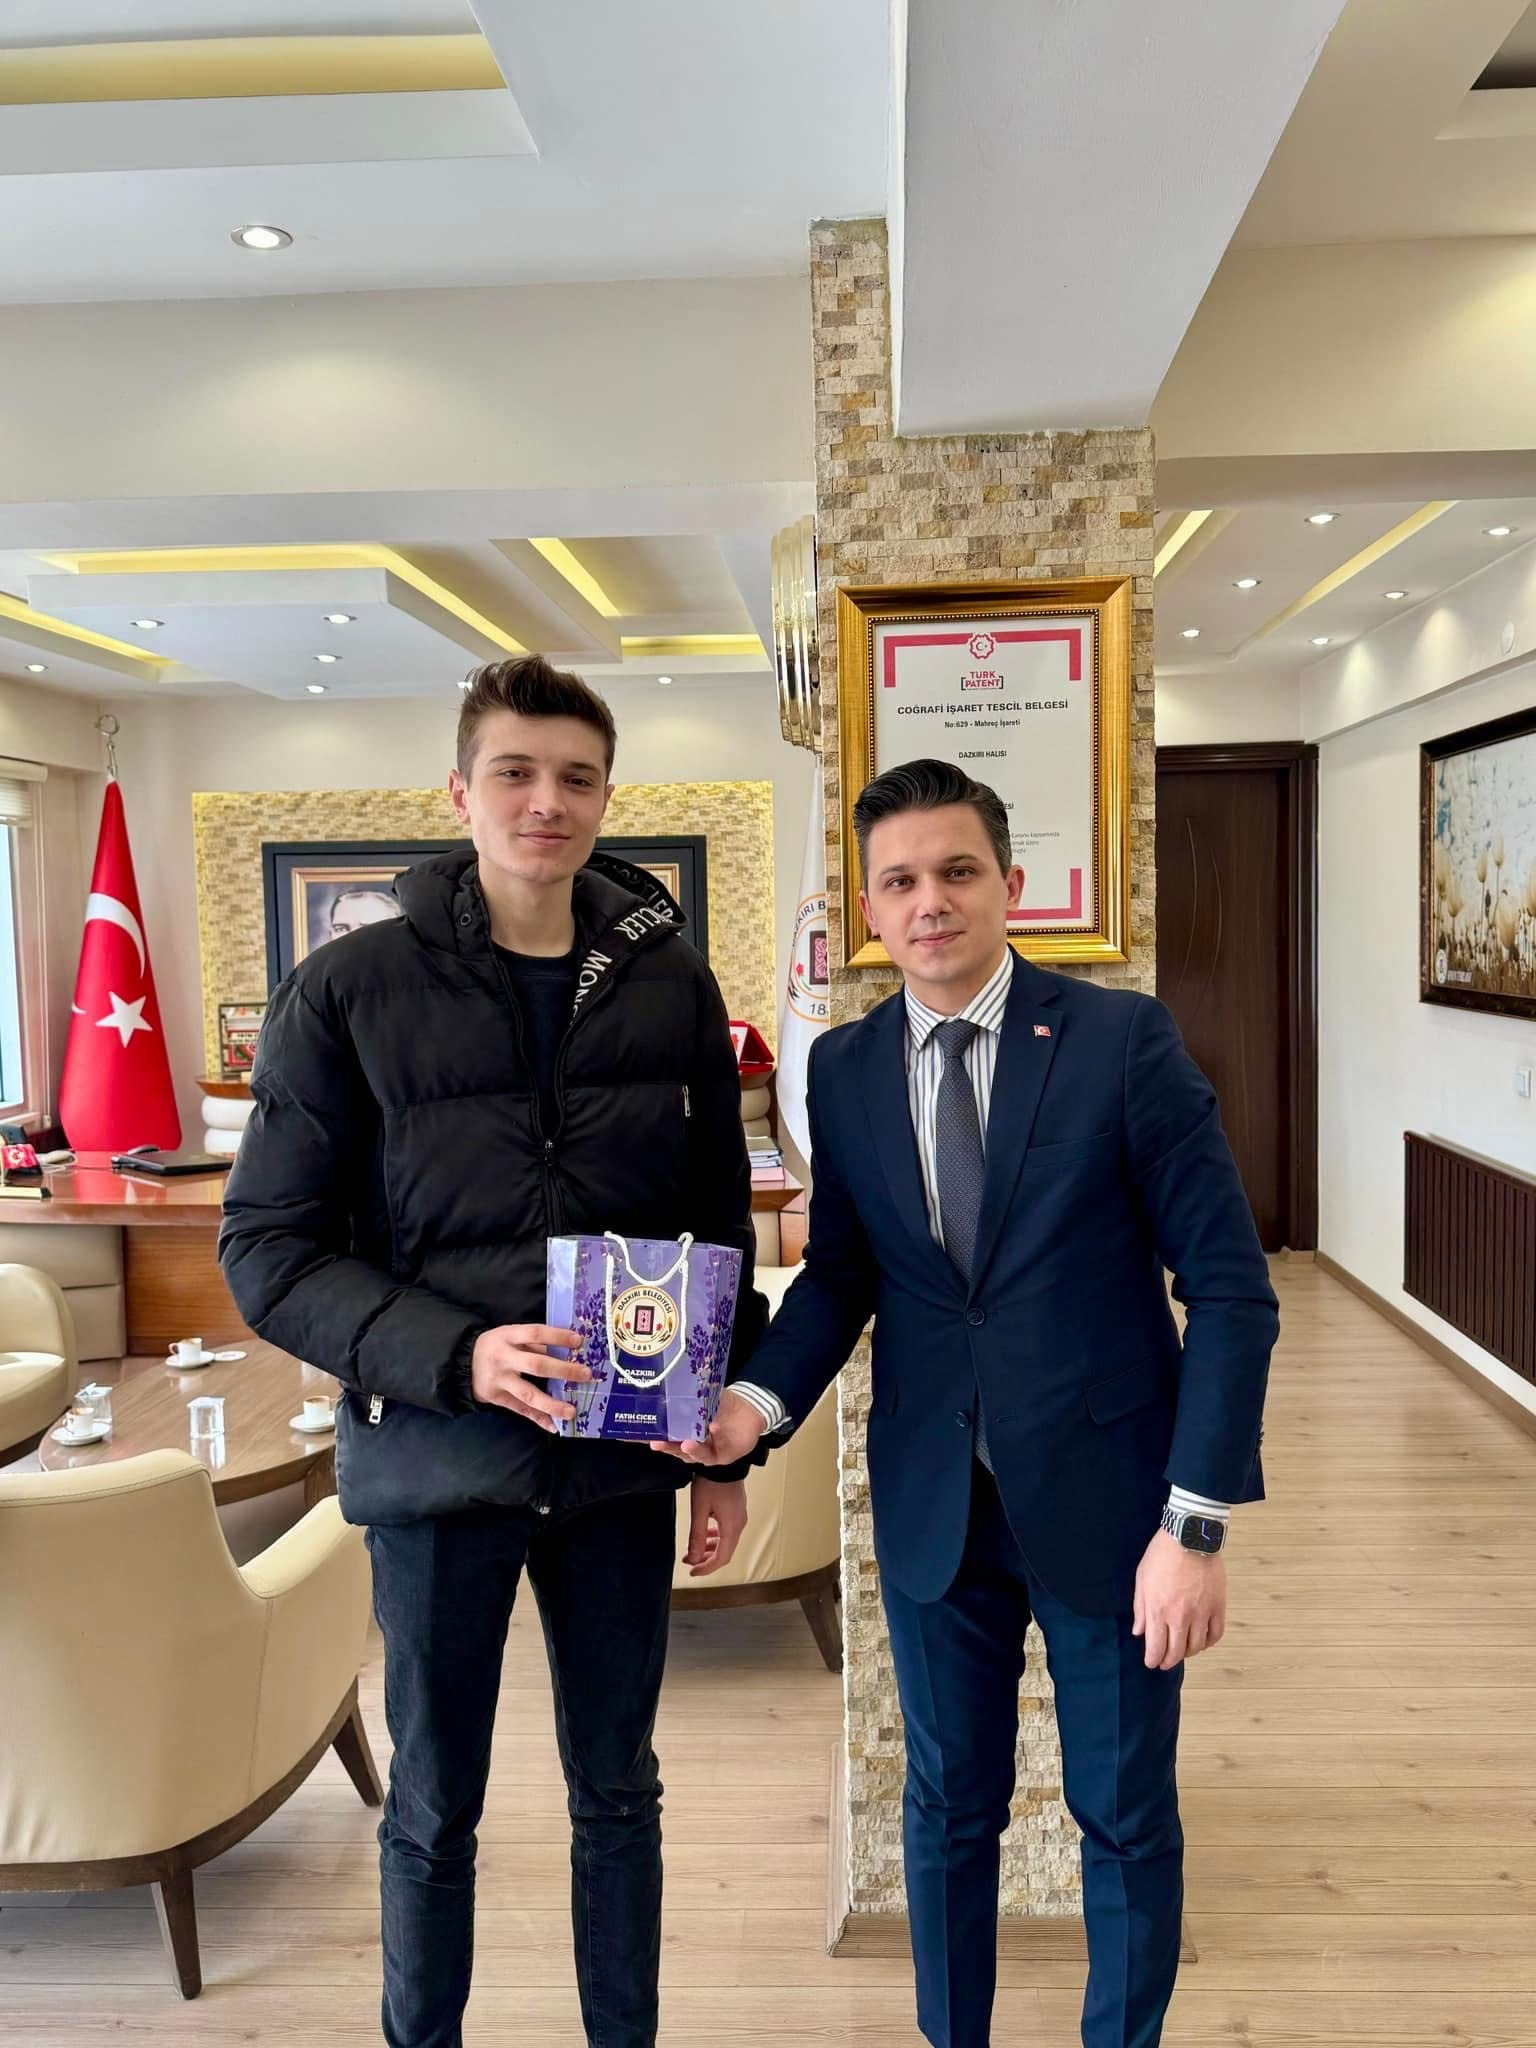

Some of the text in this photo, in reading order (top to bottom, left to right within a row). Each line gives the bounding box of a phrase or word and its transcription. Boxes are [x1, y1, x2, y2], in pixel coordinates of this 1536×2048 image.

[965, 679, 1001, 688] PATENT
[897, 699, 1068, 715] COĞRAFİ İŞARET TESCİL BELGESİ
[974, 720, 998, 729] Mahreç
[612, 907, 662, 941] CLER
[809, 1003, 829, 1015] 18
